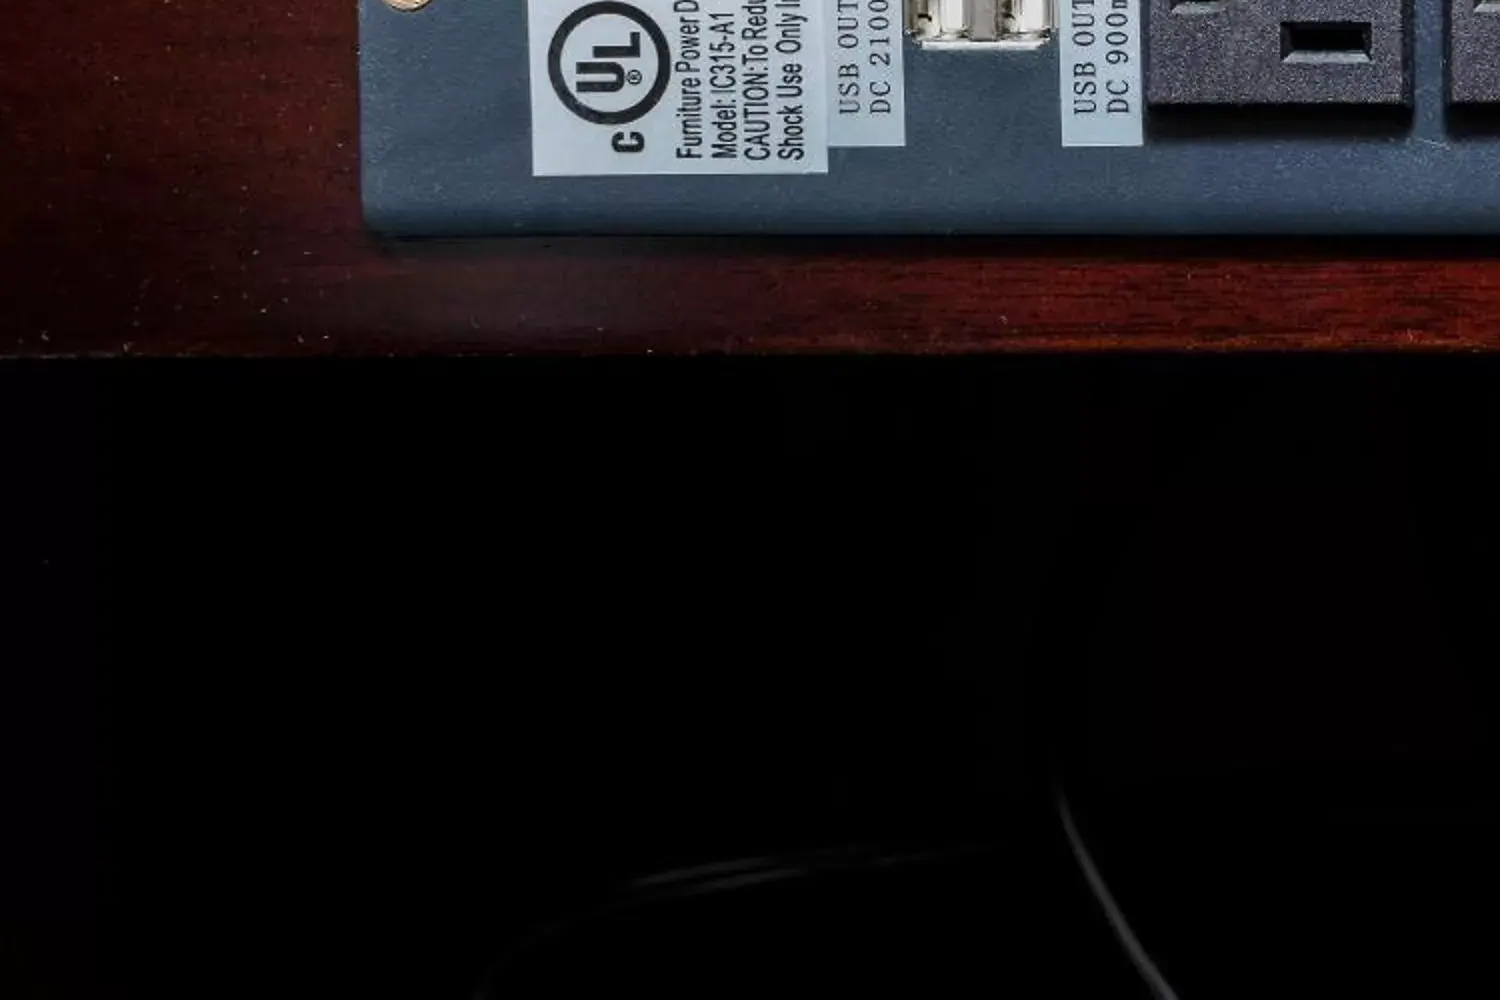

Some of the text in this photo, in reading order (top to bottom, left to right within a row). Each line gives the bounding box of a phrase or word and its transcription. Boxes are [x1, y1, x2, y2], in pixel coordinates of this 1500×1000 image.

[674, 16, 701, 73] Power
[708, 13, 737, 94] IC315-A1
[774, 12, 808, 54] Only
[575, 31, 641, 93] UL
[775, 62, 803, 98] Use
[838, 63, 861, 115] USB
[1072, 60, 1097, 114] USB
[675, 76, 703, 159] Furniture
[869, 80, 892, 114] DC
[1105, 79, 1130, 114] DC
[710, 98, 738, 159] Model:
[776, 104, 805, 162] Shock
